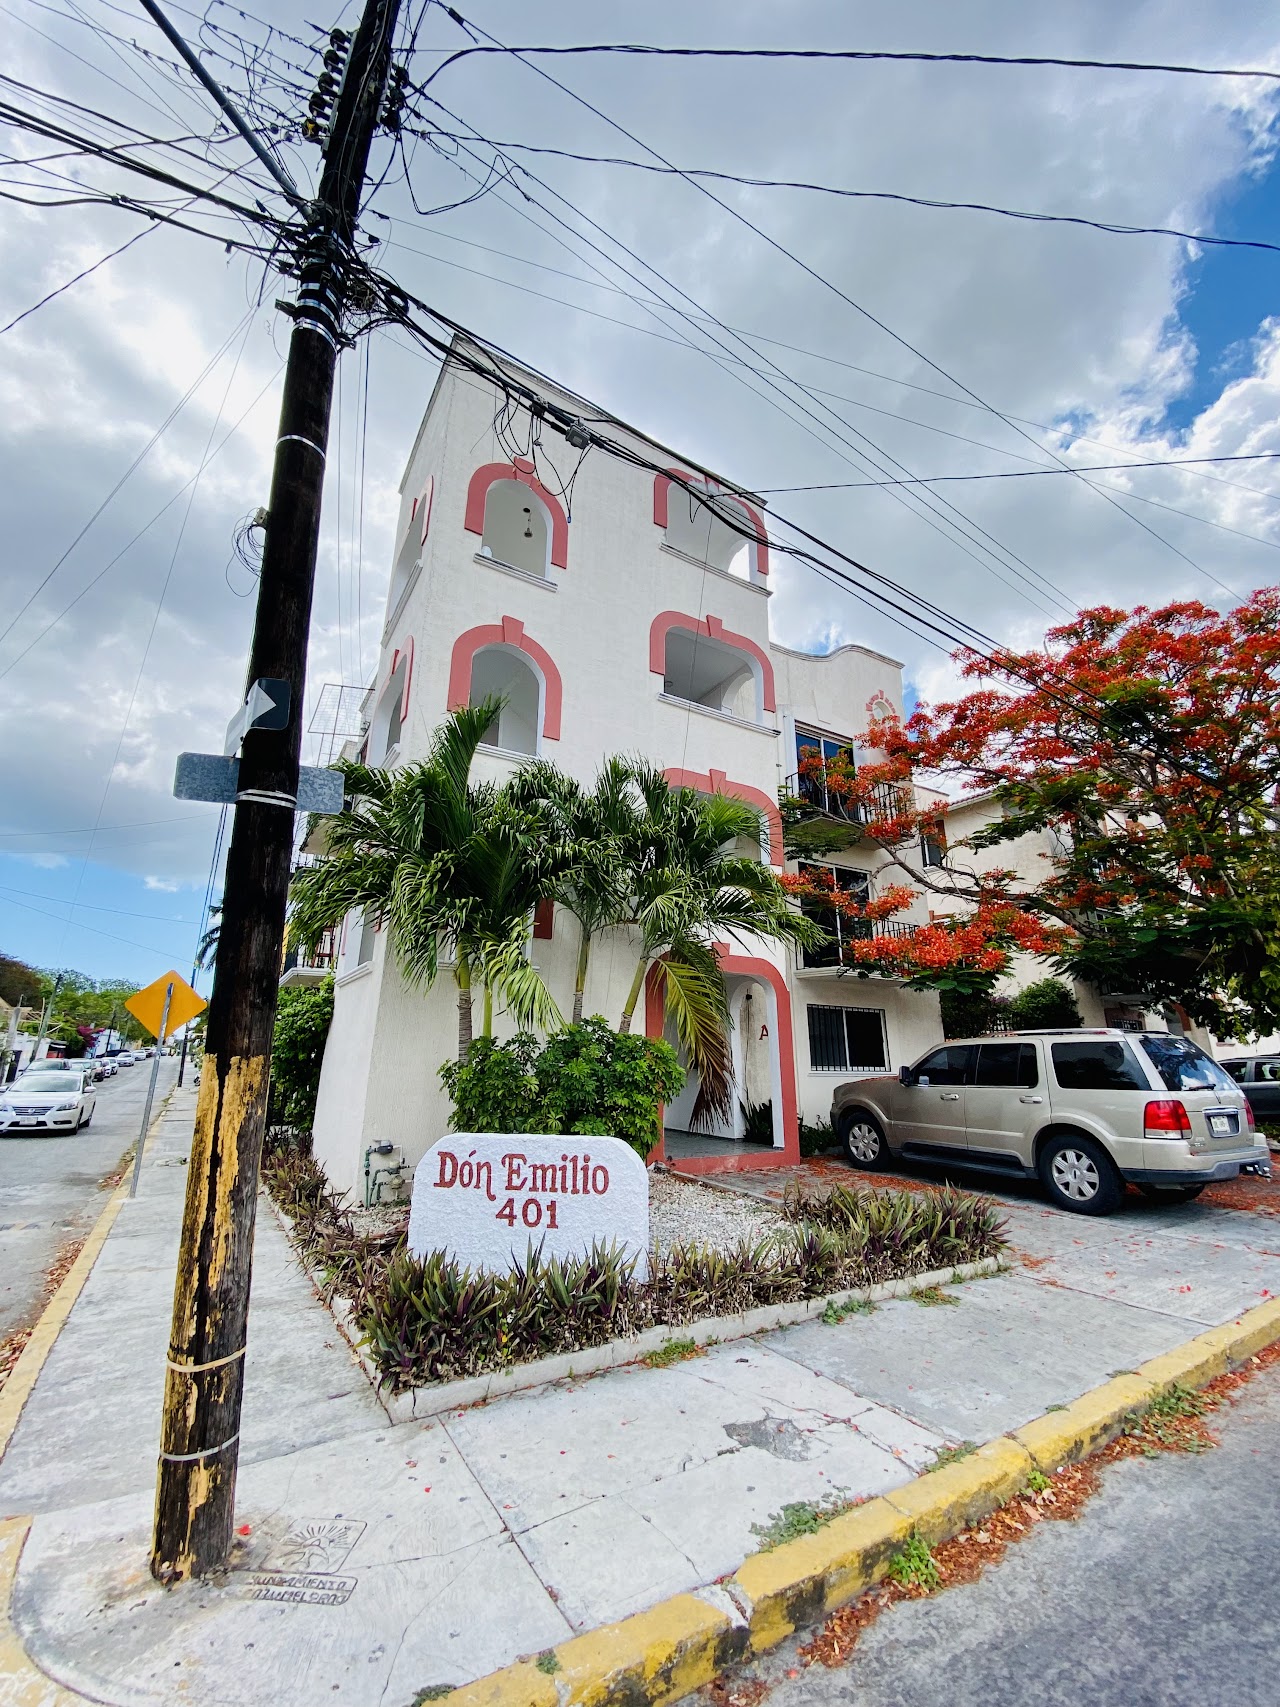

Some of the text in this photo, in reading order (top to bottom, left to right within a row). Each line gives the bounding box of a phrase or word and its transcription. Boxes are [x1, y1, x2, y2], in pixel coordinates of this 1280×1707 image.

[759, 1024, 769, 1040] A
[433, 1150, 609, 1201] Dón Emilio
[495, 1198, 558, 1229] 401
